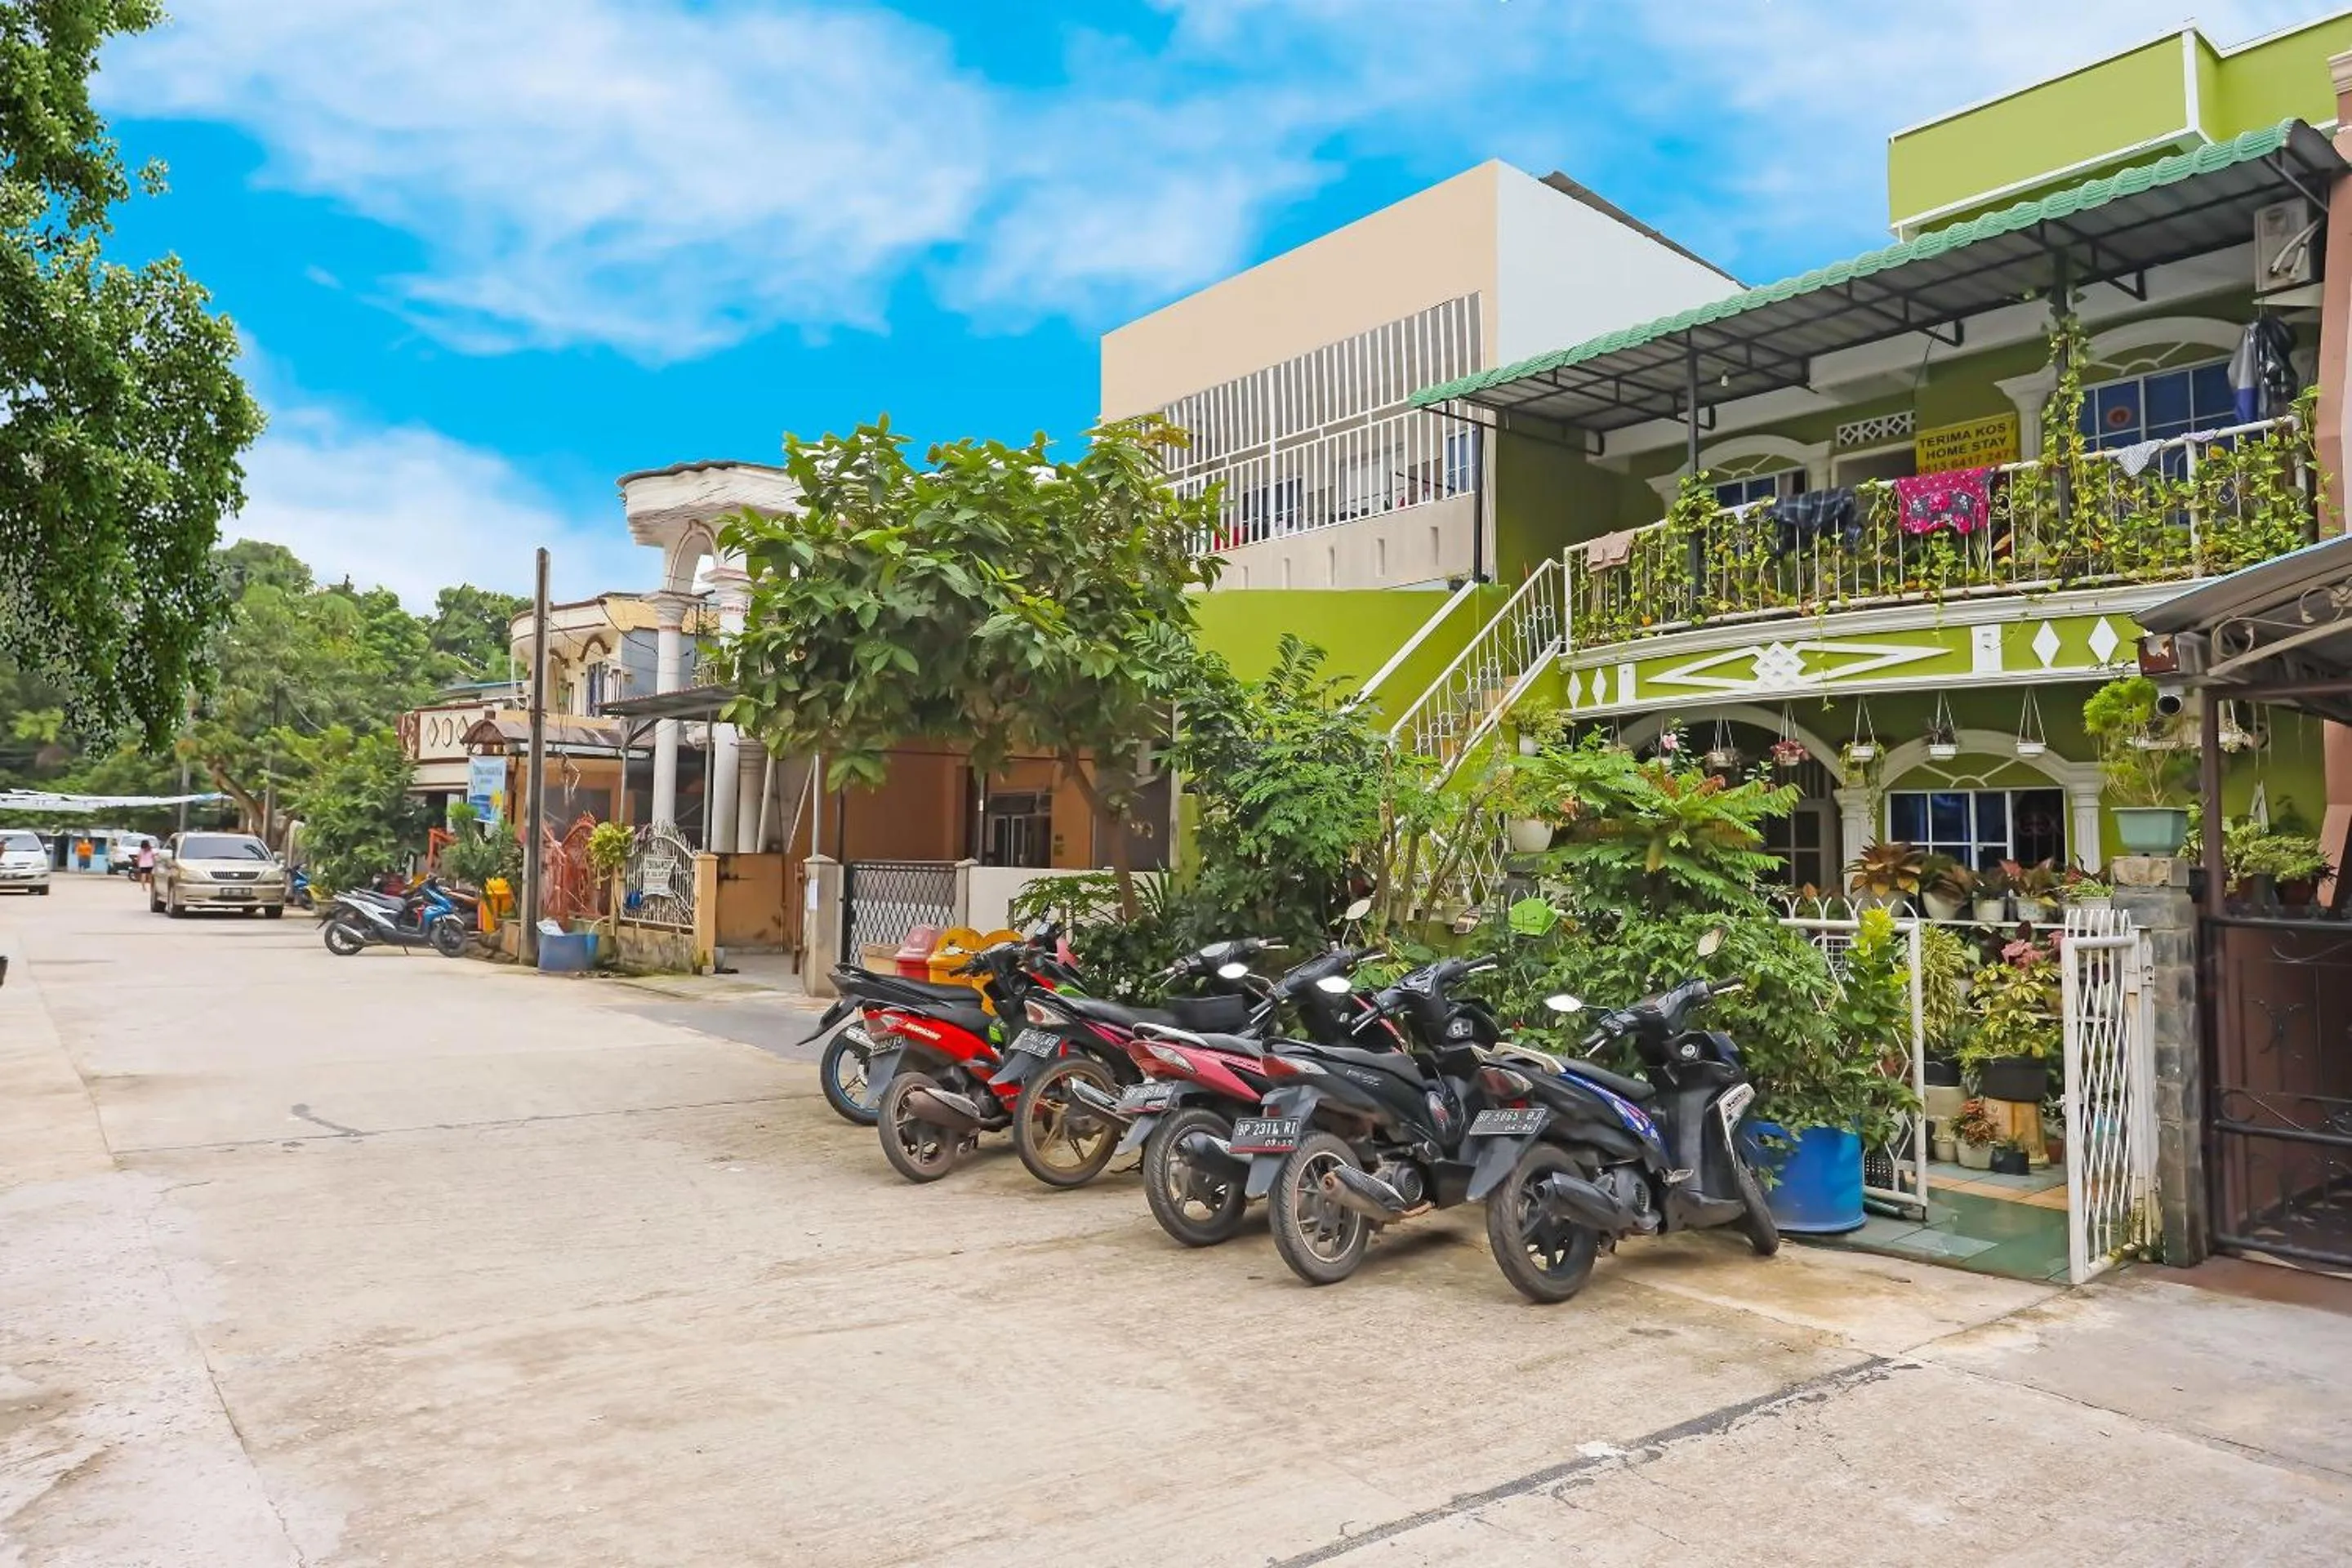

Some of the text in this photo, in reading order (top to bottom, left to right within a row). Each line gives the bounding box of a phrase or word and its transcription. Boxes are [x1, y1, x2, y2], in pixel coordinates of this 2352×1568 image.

[1919, 430, 1971, 448] TERIMA
[1976, 423, 2007, 437] KOS
[1927, 436, 2007, 460] HOME STAY
